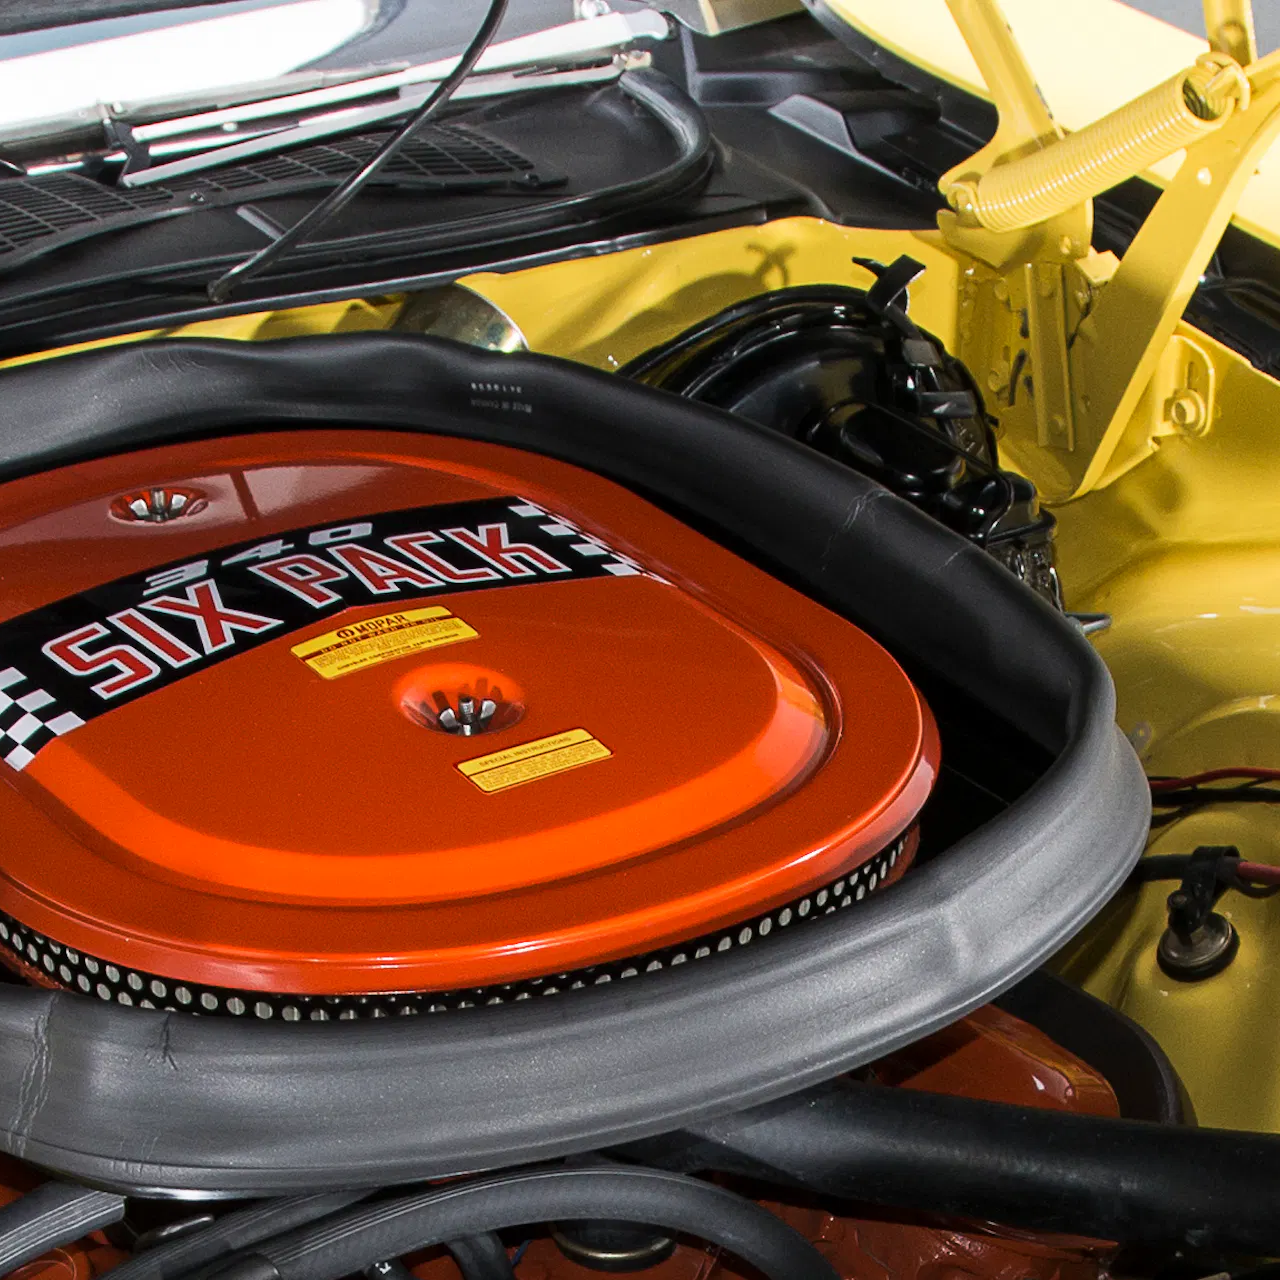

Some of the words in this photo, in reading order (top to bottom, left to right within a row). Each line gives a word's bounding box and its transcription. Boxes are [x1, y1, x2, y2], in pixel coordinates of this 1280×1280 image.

[141, 521, 373, 595] 340
[39, 580, 285, 702] SIX
[247, 523, 572, 610] PACK
[353, 613, 409, 635] MOPAR
[478, 753, 512, 768] SPECIAL
[512, 735, 573, 758] INSTRUCTIONS
